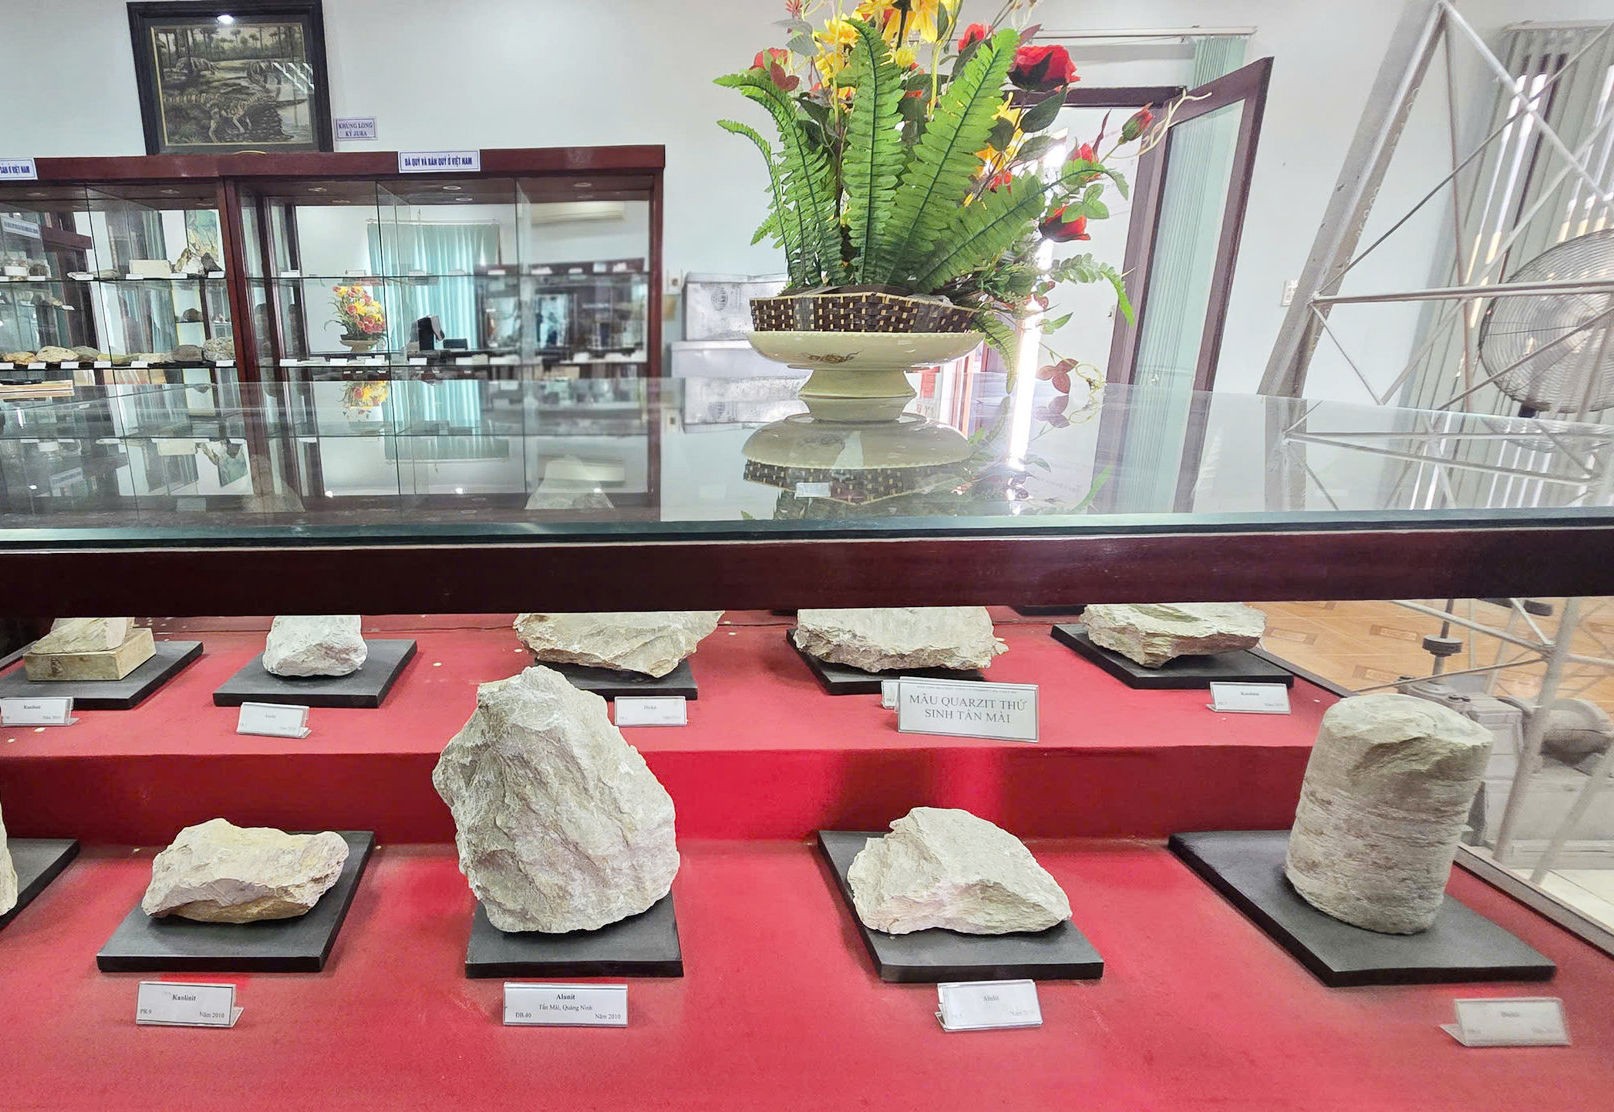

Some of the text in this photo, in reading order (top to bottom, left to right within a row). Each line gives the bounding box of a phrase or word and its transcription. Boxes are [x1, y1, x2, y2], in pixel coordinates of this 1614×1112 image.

[452, 156, 461, 167] VIỆT
[462, 157, 473, 165] NAM
[941, 695, 996, 709] QUARZIT
[999, 698, 1028, 711] THỨ
[924, 708, 953, 719] SINH
